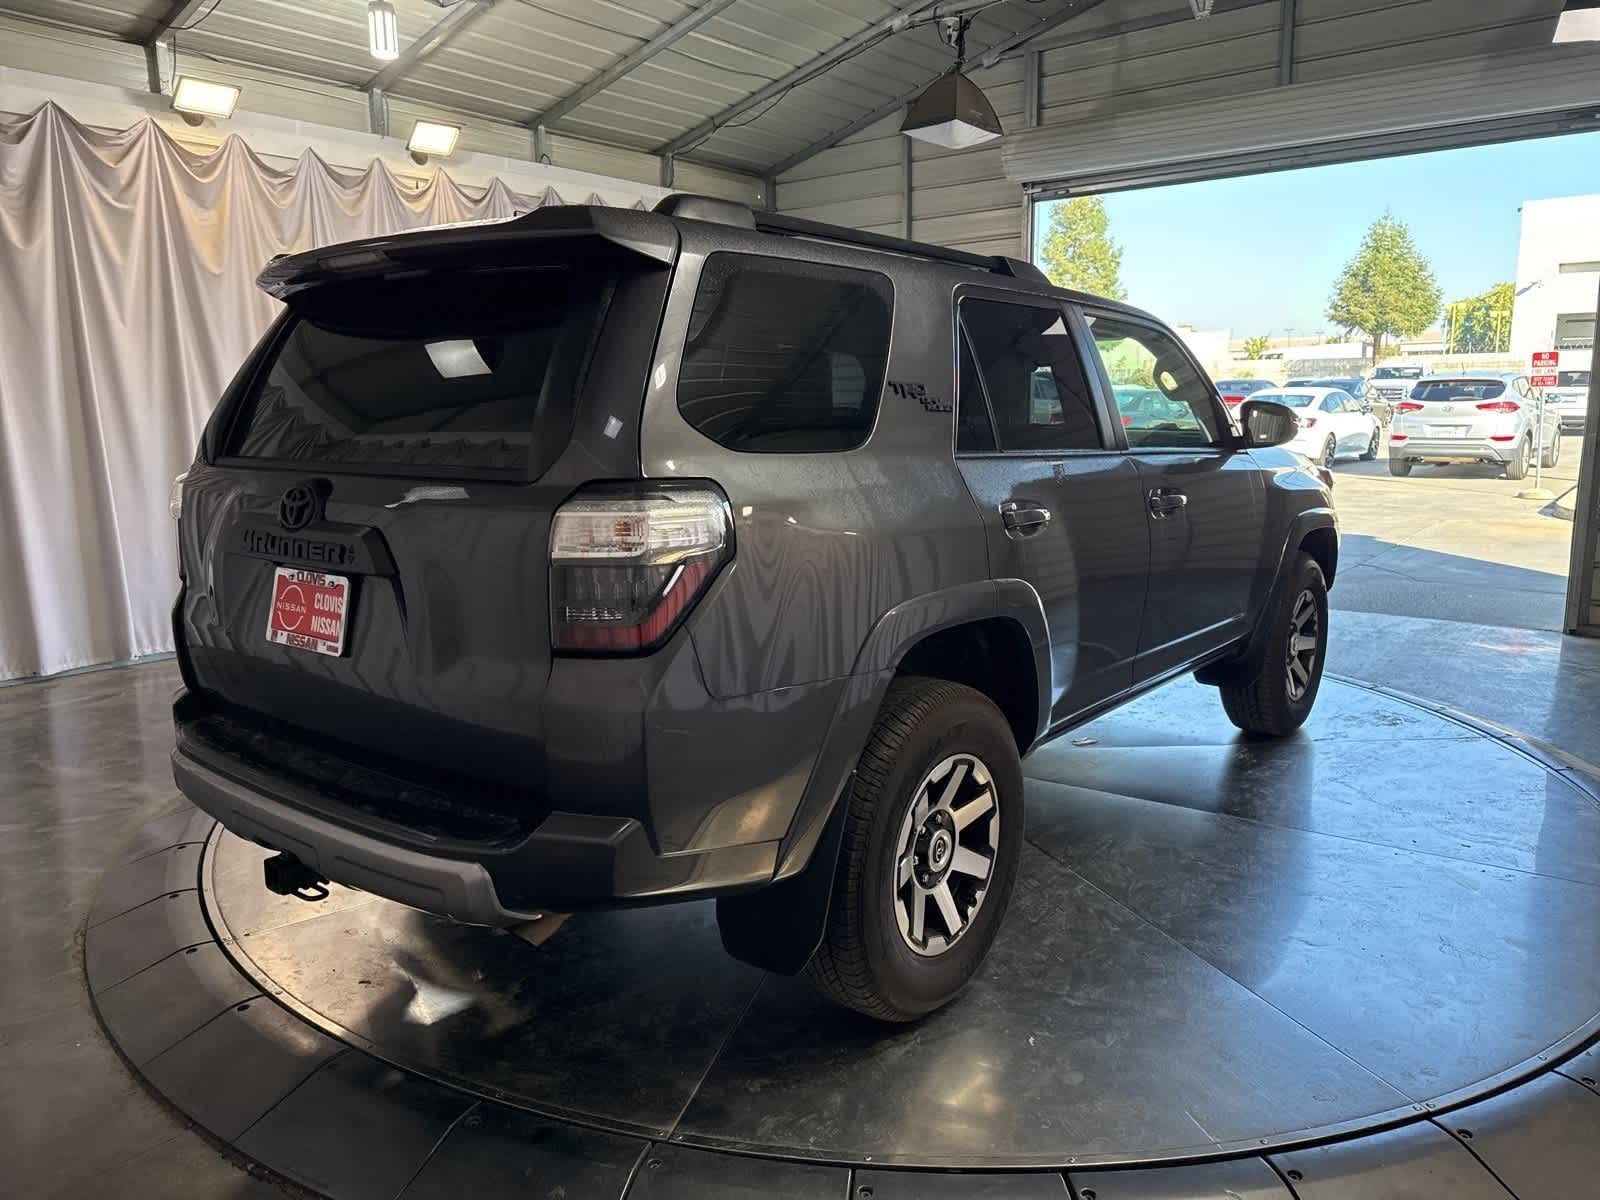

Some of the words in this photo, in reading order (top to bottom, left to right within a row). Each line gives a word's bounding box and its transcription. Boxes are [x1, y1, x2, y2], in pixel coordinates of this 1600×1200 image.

[297, 572, 326, 586] CLOVIS
[277, 601, 306, 614] NISSAN
[314, 592, 343, 614] CLOVIS
[286, 633, 318, 650] NISSAN
